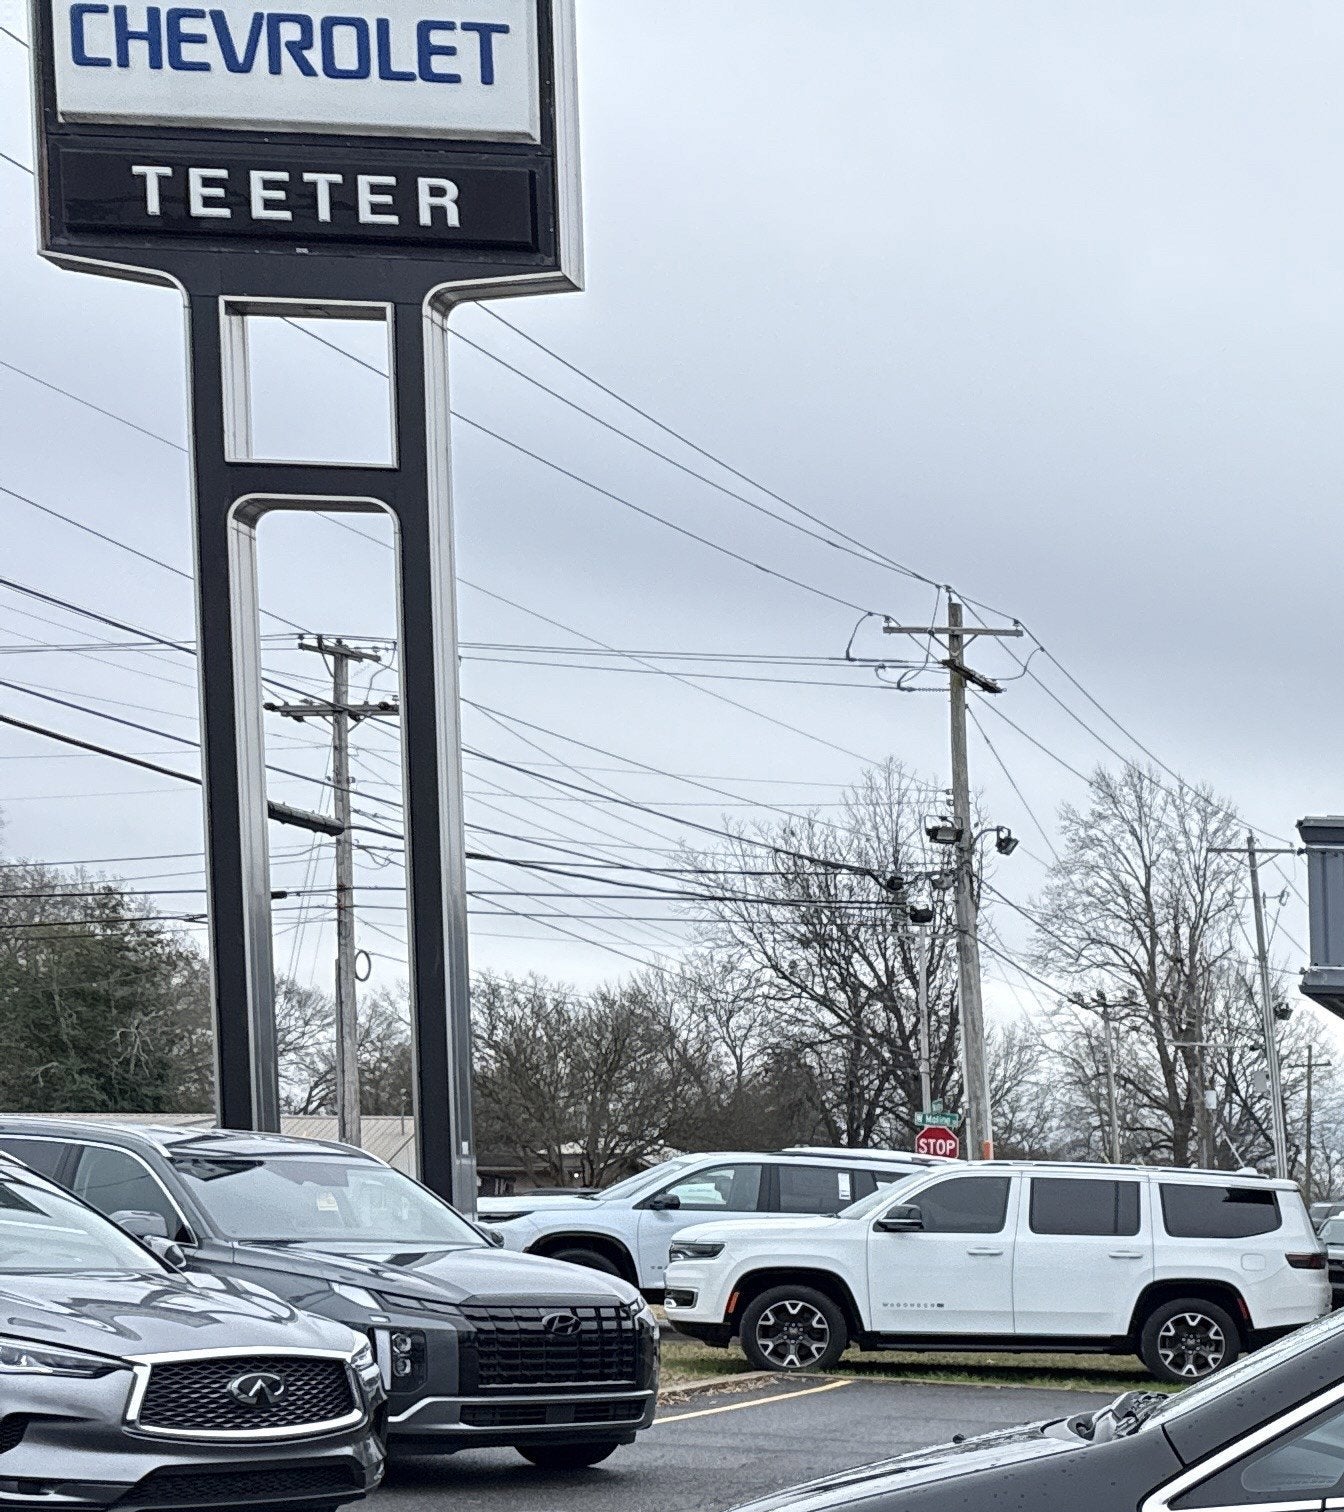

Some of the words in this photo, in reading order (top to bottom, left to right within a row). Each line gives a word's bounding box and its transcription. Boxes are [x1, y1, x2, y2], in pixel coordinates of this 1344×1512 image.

[70, 2, 510, 86] CHEVROLET
[131, 164, 461, 228] TEETER
[918, 1138, 956, 1155] STOP
